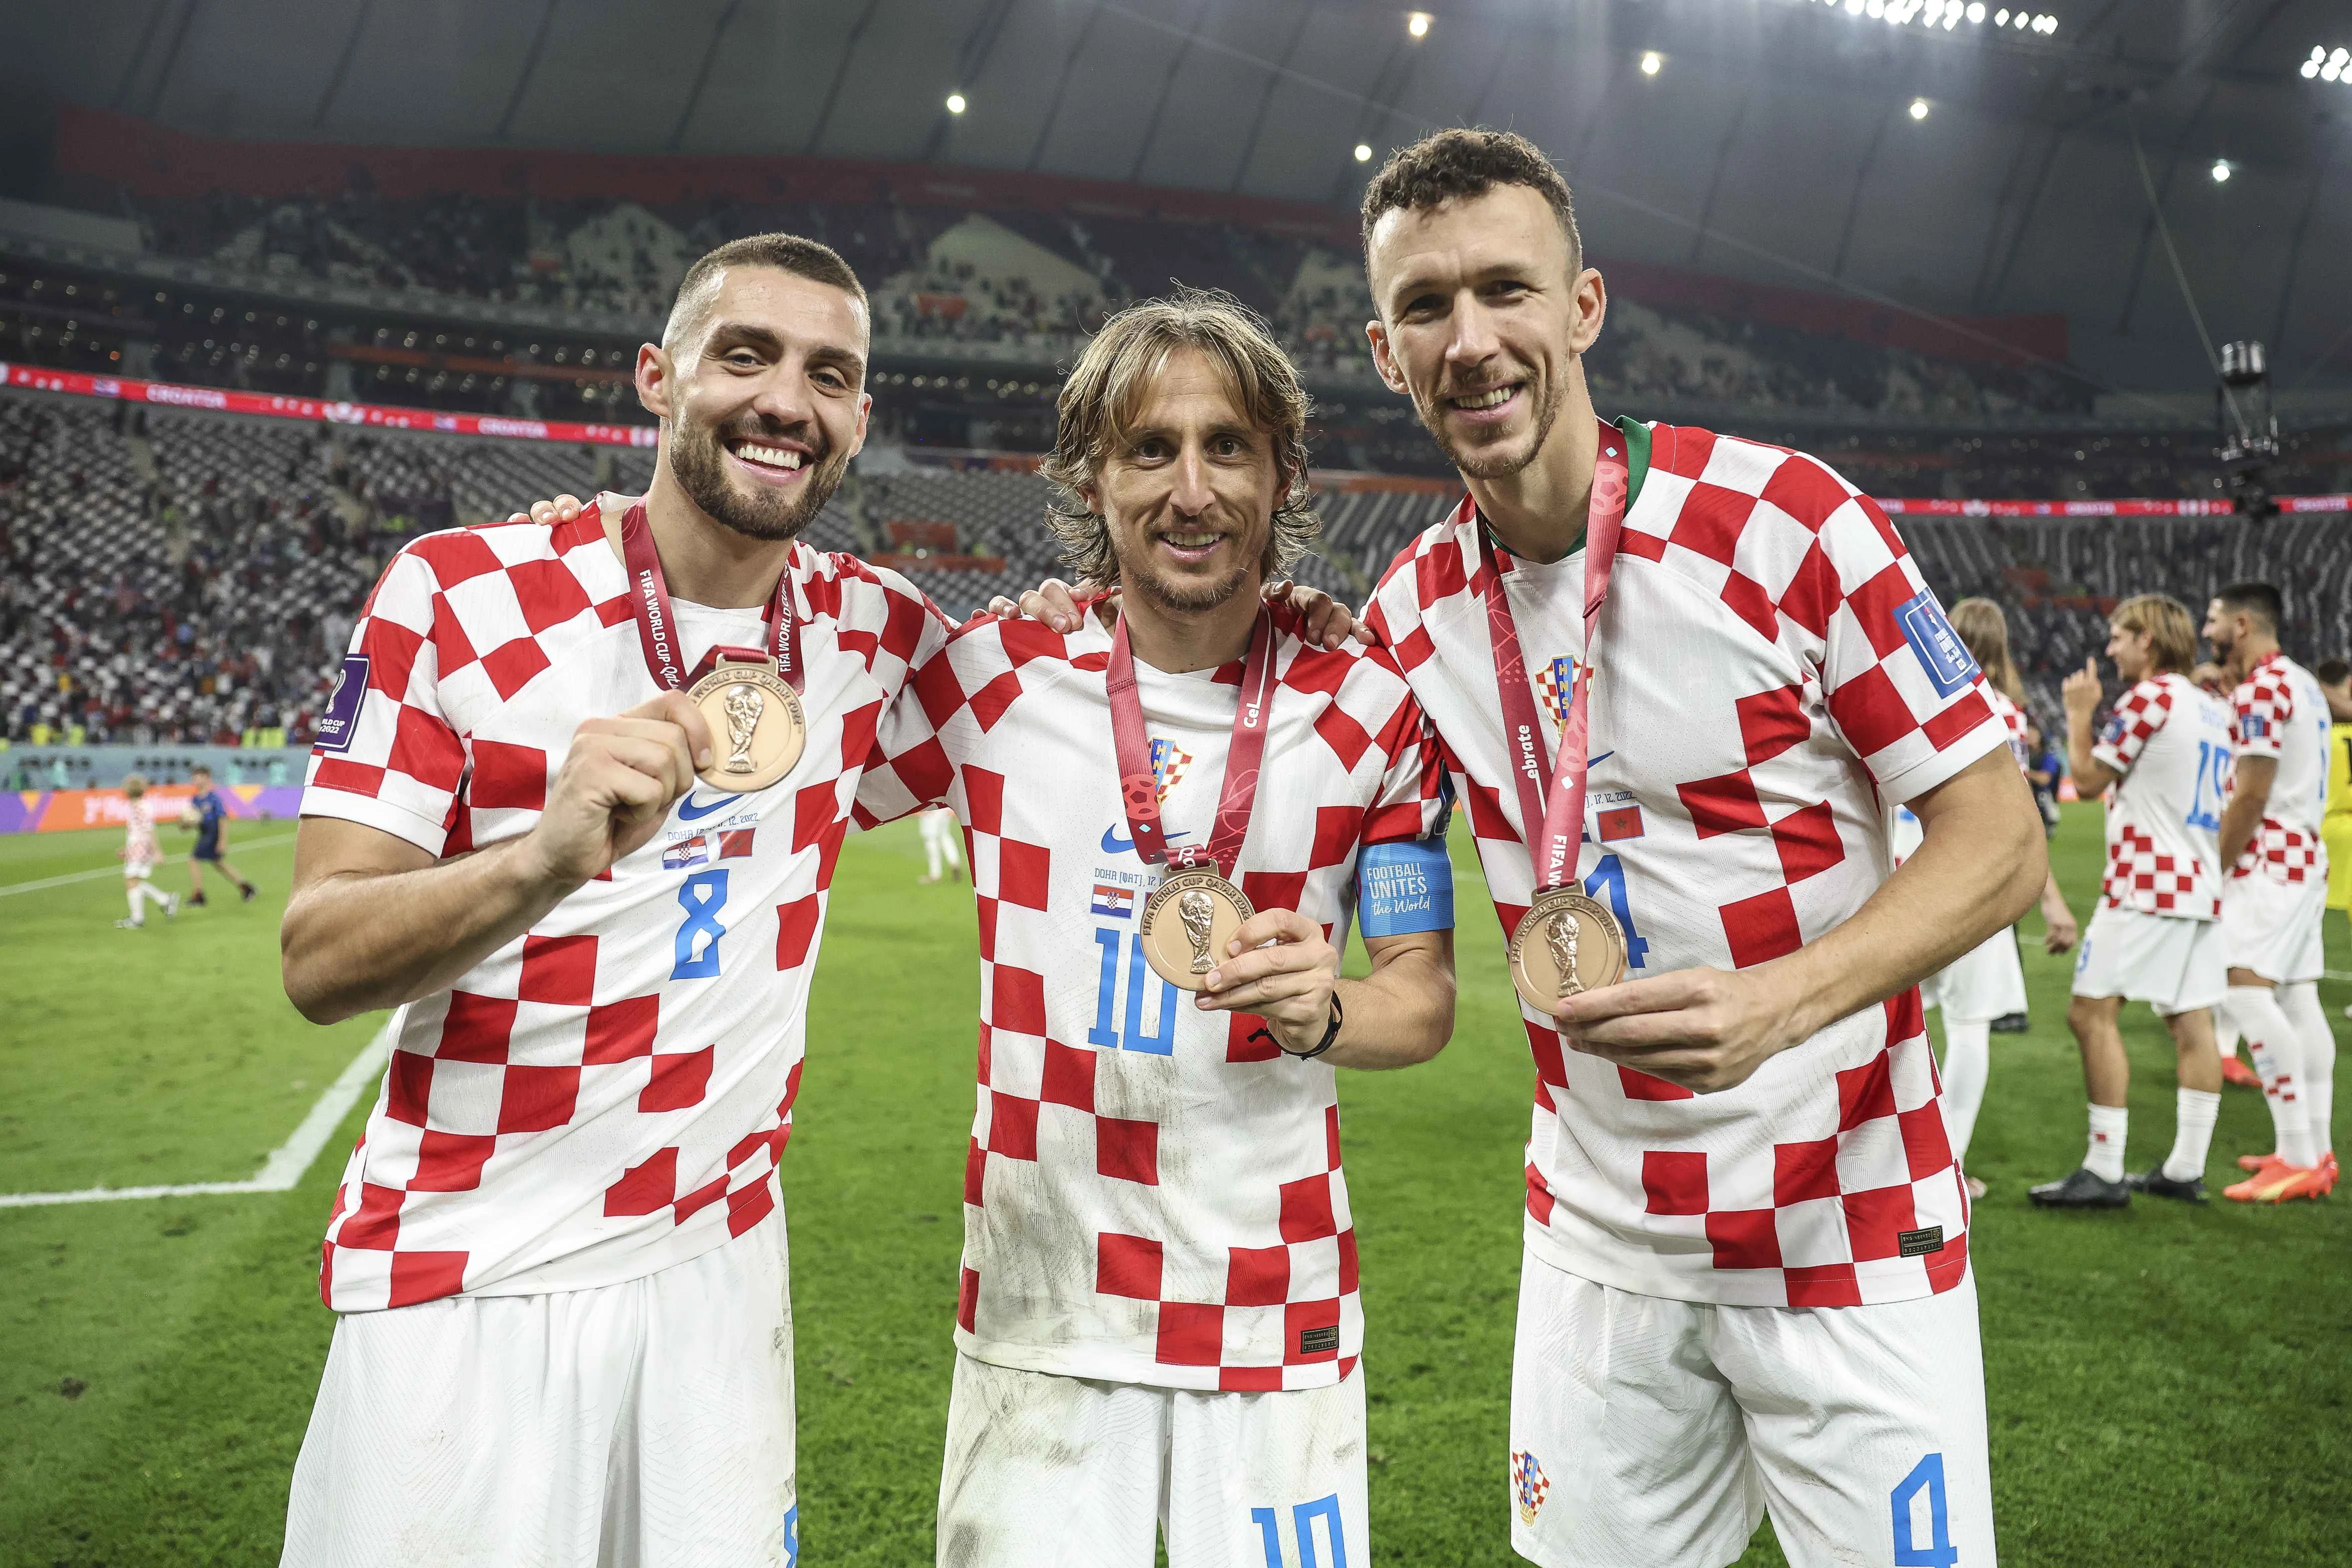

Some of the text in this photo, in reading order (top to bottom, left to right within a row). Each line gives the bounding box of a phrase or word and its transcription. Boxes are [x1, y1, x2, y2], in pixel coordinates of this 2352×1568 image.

[640, 568, 656, 599] FIFA
[781, 583, 789, 608] CUP
[646, 596, 666, 642] WORLD
[778, 608, 792, 652] WORLD
[655, 642, 671, 664] CUP
[779, 653, 791, 673] FIFA
[1558, 664, 1570, 710] HNS
[668, 829, 694, 841] DOHA
[1550, 834, 1568, 869] FIFA
[1094, 868, 1116, 880] DOHA
[1366, 862, 1424, 881] FOOTBALL
[1368, 876, 1428, 899] UNITES
[1143, 878, 1252, 936] FIFA WORLD CUP QATAR 2022
[1372, 896, 1430, 916] the World
[1518, 904, 1546, 936] WORLD
[669, 869, 729, 981] 8
[1088, 927, 1178, 1056] 10
[1891, 1452, 1958, 1568] 4
